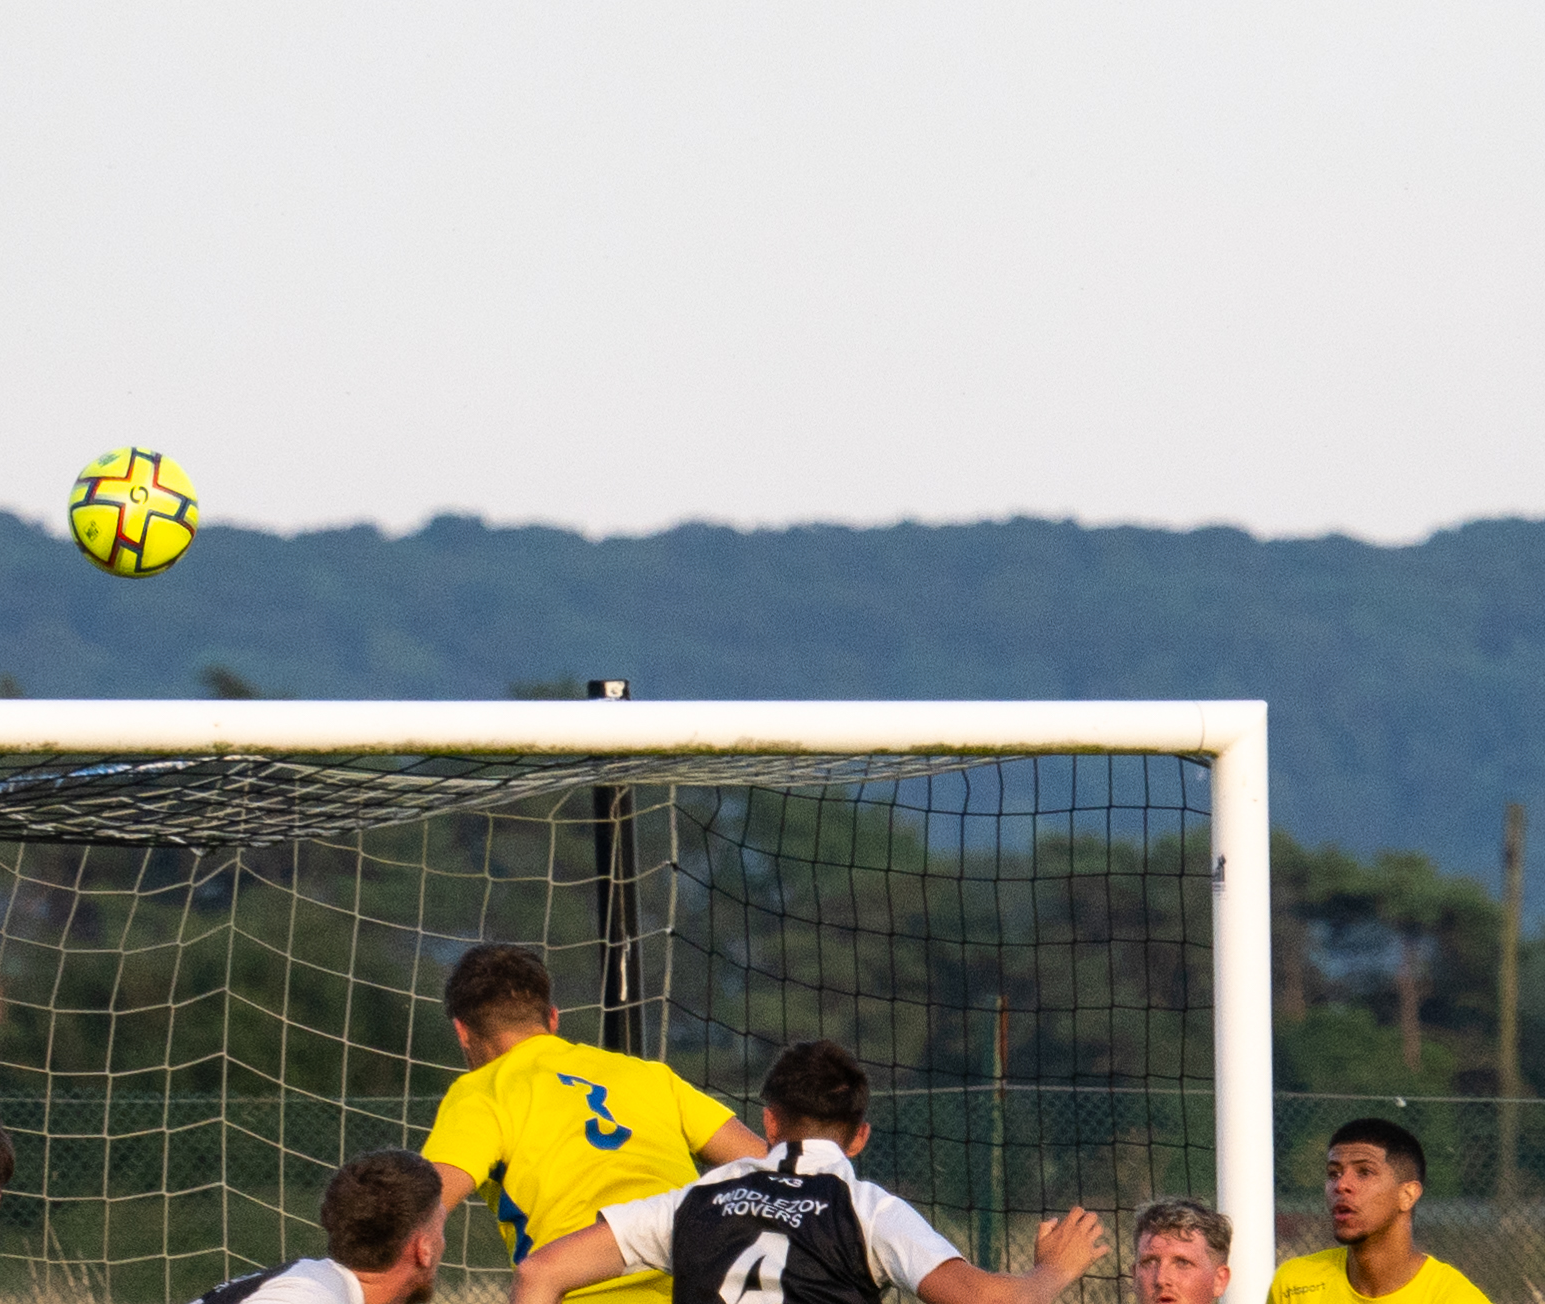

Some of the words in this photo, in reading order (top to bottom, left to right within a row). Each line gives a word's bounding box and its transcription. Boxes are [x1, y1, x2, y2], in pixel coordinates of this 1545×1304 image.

[556, 1072, 633, 1151] 3
[712, 1188, 829, 1216] MIDDLEZOY
[721, 1201, 803, 1228] ROVERS
